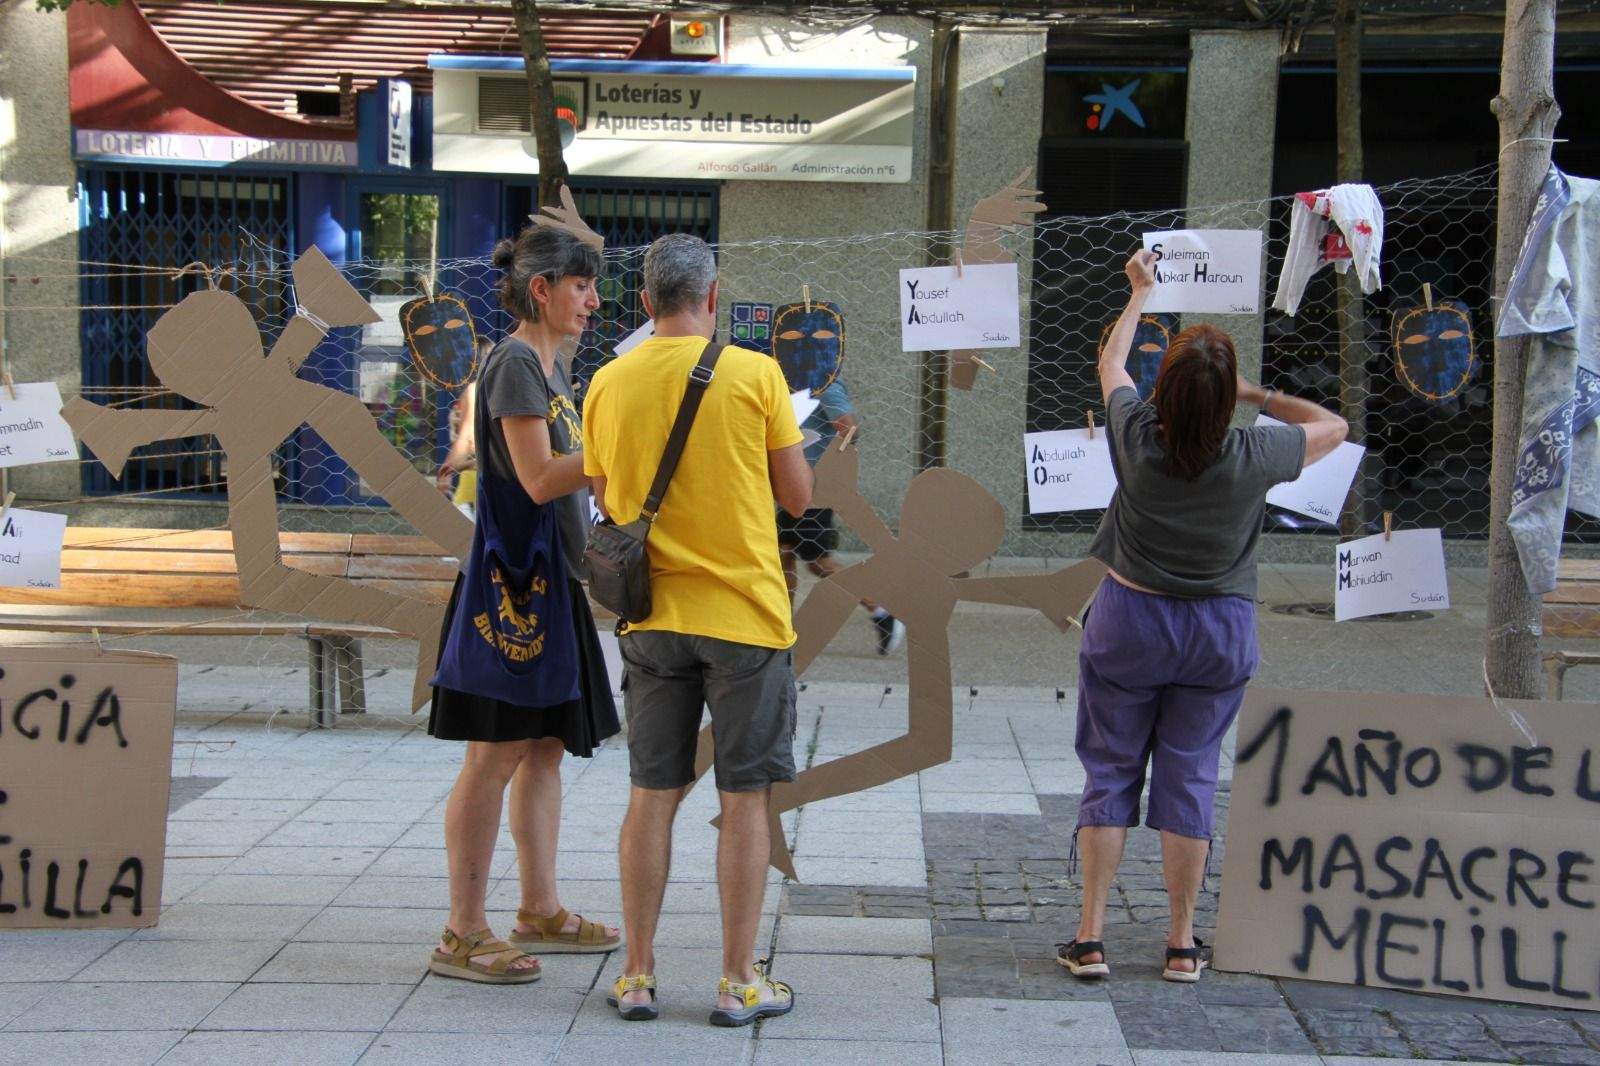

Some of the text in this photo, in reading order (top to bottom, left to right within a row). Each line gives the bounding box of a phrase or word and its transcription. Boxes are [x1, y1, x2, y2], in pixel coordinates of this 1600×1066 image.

[595, 83, 702, 110] Loterías y
[595, 111, 812, 135] Apuestas del Estado
[87, 131, 347, 163] LOTERIA Y PRIMITIVA
[698, 162, 777, 173] Alfonso Gallán
[792, 163, 873, 175] Administración
[1151, 243, 1210, 261] Suleiman
[1194, 262, 1243, 283] Haroun
[907, 279, 952, 300] Yousef
[908, 304, 965, 325] Abdullah
[1032, 444, 1086, 464] Abdullah
[1034, 466, 1073, 486] Omar
[1340, 549, 1382, 570] Marwan
[1339, 570, 1393, 591] Mohiuddin
[1235, 705, 1293, 807] 1
[1301, 728, 1442, 798] AÑO
[1455, 740, 1556, 798] DE
[1258, 833, 1598, 910] MASACRE
